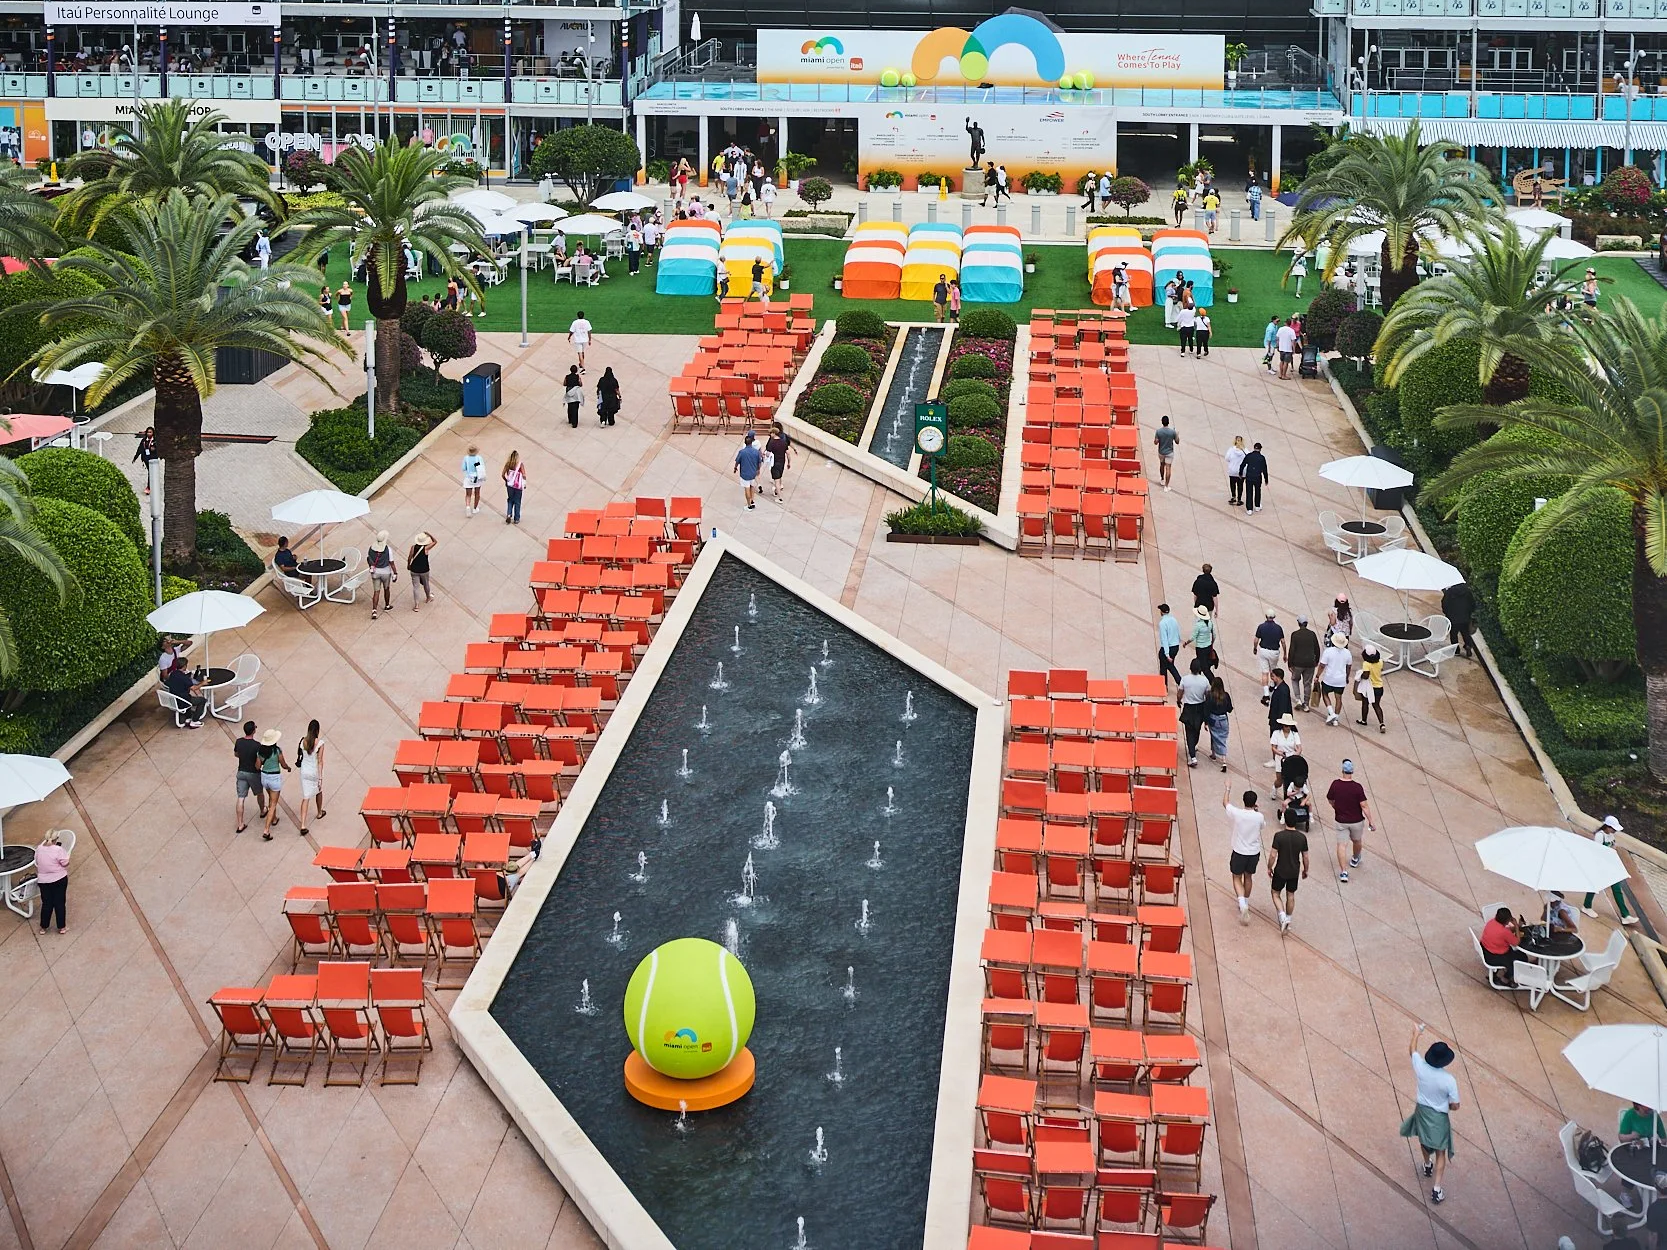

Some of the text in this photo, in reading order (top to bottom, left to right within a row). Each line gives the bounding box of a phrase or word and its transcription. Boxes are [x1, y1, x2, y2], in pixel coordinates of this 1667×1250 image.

[57, 6, 219, 22] Itaú Personnalité Lounge
[1142, 48, 1180, 62] Tennis
[1162, 62, 1181, 70] Play
[116, 106, 211, 115] MIAM HOP
[265, 132, 321, 151] OPEN
